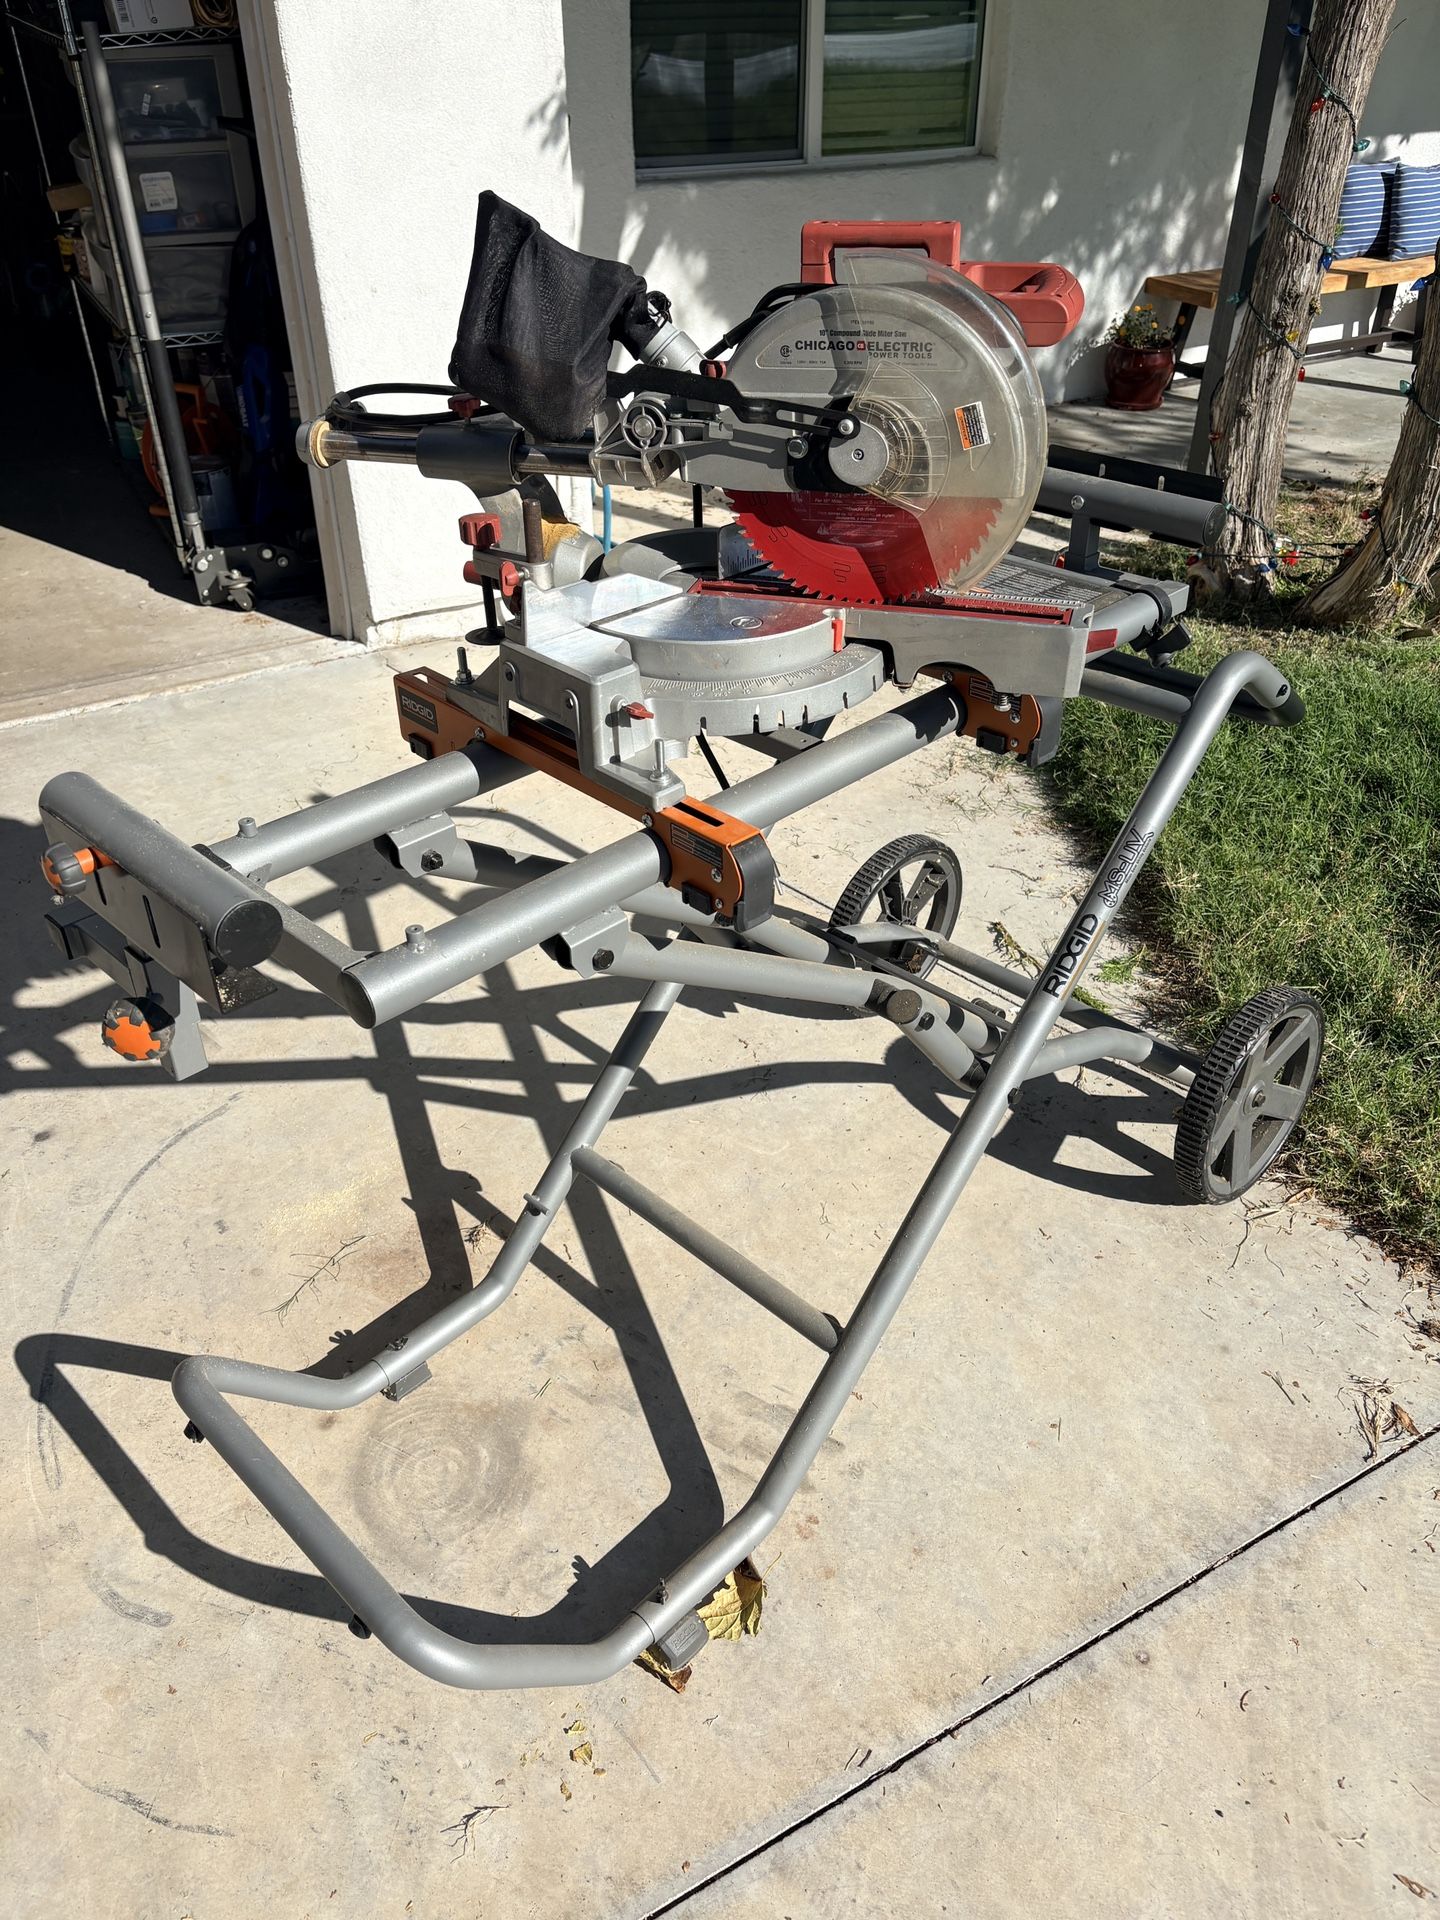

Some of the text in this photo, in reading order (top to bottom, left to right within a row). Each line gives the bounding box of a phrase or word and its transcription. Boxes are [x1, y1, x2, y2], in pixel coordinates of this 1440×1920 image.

[819, 329, 828, 337] 10"
[829, 329, 861, 338] Compound
[877, 330, 893, 338] Miter
[894, 330, 907, 338] Saw
[795, 340, 855, 351] CHICAGO
[867, 341, 933, 352] ELECTRIC
[903, 352, 933, 360] TOOLS
[401, 695, 434, 720] RIDGID
[1043, 913, 1099, 998] RIDGID
